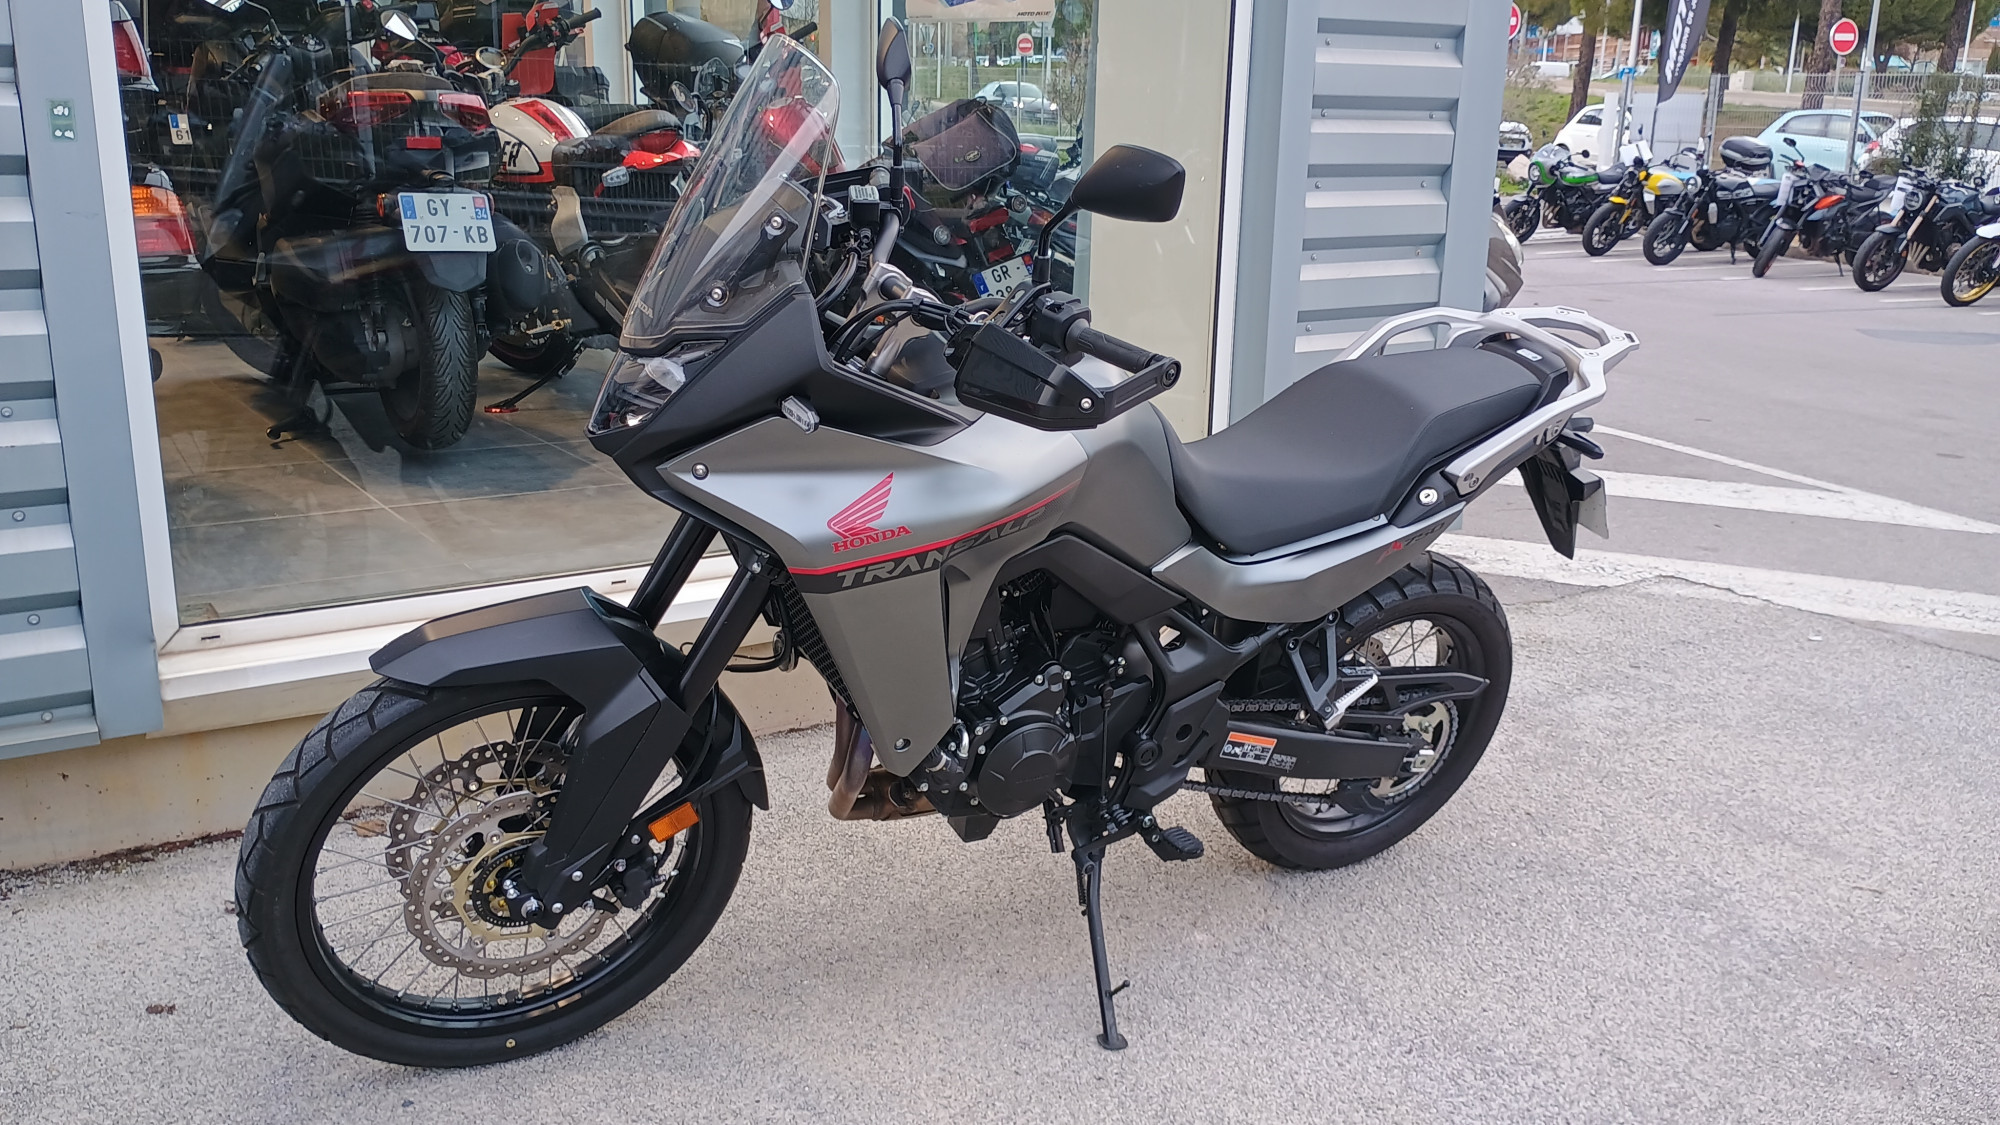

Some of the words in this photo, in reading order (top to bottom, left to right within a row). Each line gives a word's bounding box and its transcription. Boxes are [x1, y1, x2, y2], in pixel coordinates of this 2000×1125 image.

[502, 141, 523, 168] ER
[426, 198, 450, 217] GY
[475, 208, 488, 219] 34
[991, 264, 1012, 283] GR
[832, 526, 912, 553] HONDA
[837, 507, 1046, 588] TRANSALP
